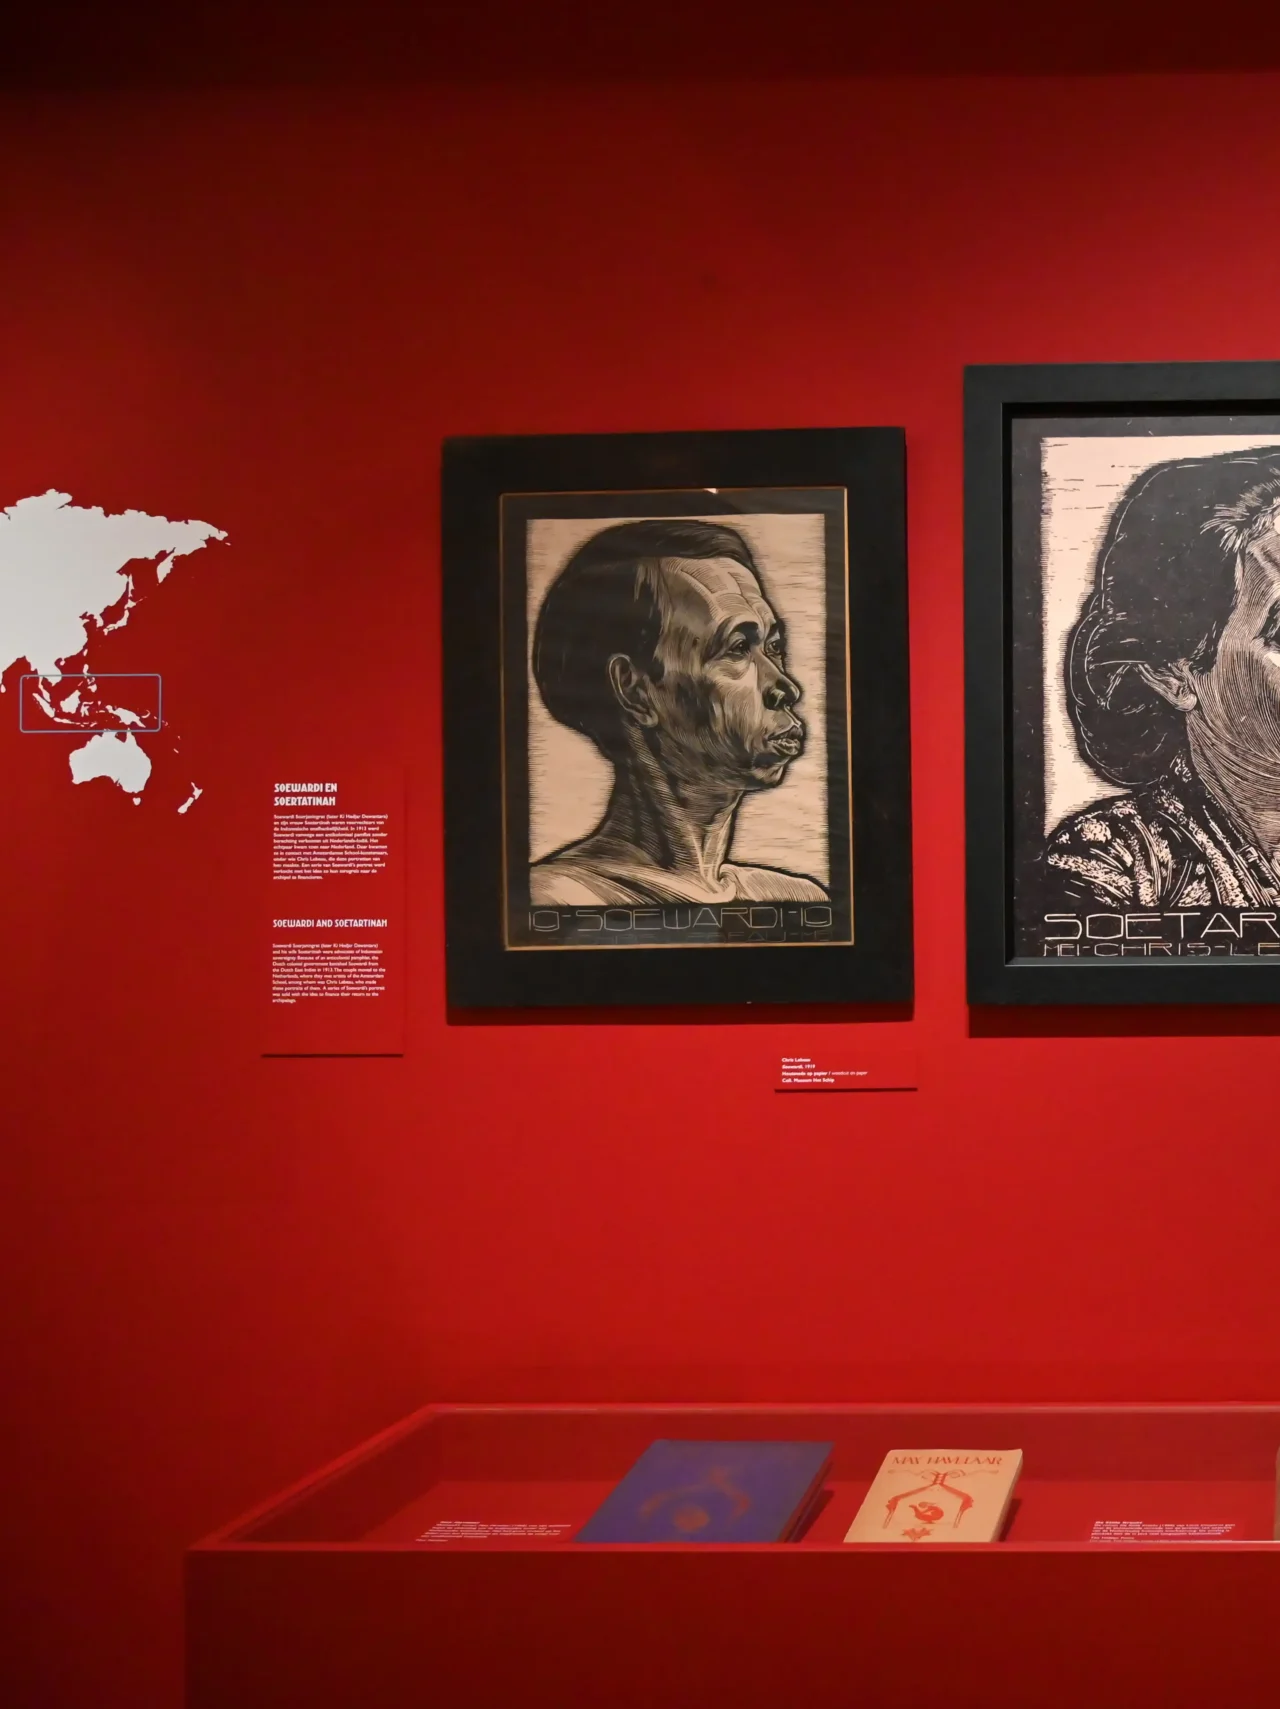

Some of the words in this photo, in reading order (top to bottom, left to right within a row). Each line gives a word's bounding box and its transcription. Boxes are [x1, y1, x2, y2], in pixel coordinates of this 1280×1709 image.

[274, 783, 323, 793] SOEWARDI
[325, 783, 337, 793] EN
[273, 796, 336, 806] SOERTATINAH
[273, 919, 315, 928] SOEWARDI
[316, 919, 333, 928] AND
[335, 919, 388, 928] SOETARTINAH
[892, 1456, 921, 1465] MAX
